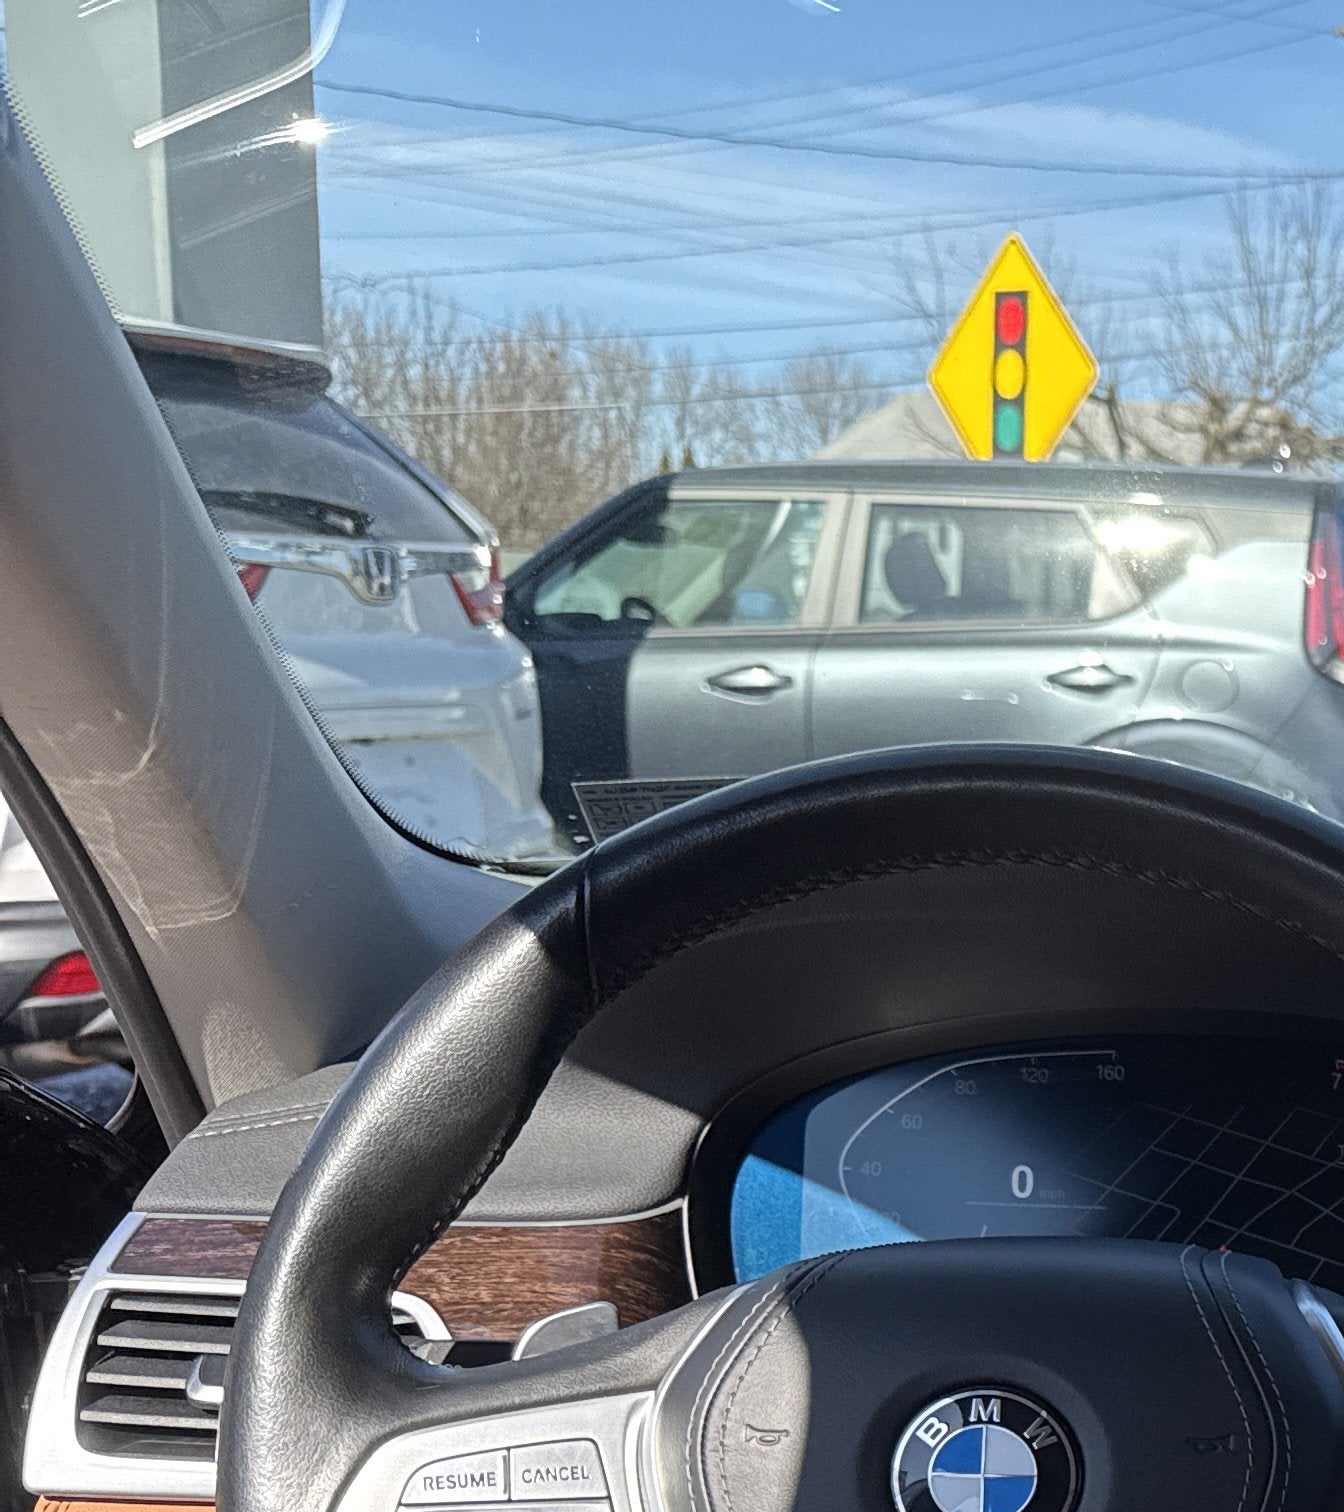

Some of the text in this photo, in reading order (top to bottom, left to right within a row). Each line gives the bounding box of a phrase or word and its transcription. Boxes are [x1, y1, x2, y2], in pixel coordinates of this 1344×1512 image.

[1020, 1067, 1049, 1083] 120
[1097, 1065, 1126, 1082] 160
[1331, 1072, 1342, 1090] 7
[954, 1080, 977, 1096] 80
[901, 1115, 923, 1130] 60
[860, 1161, 882, 1177] 40
[1011, 1165, 1034, 1199] 0
[915, 1397, 1058, 1451] BMW
[422, 1471, 498, 1491] RESUME
[522, 1465, 591, 1485] CANCEL
